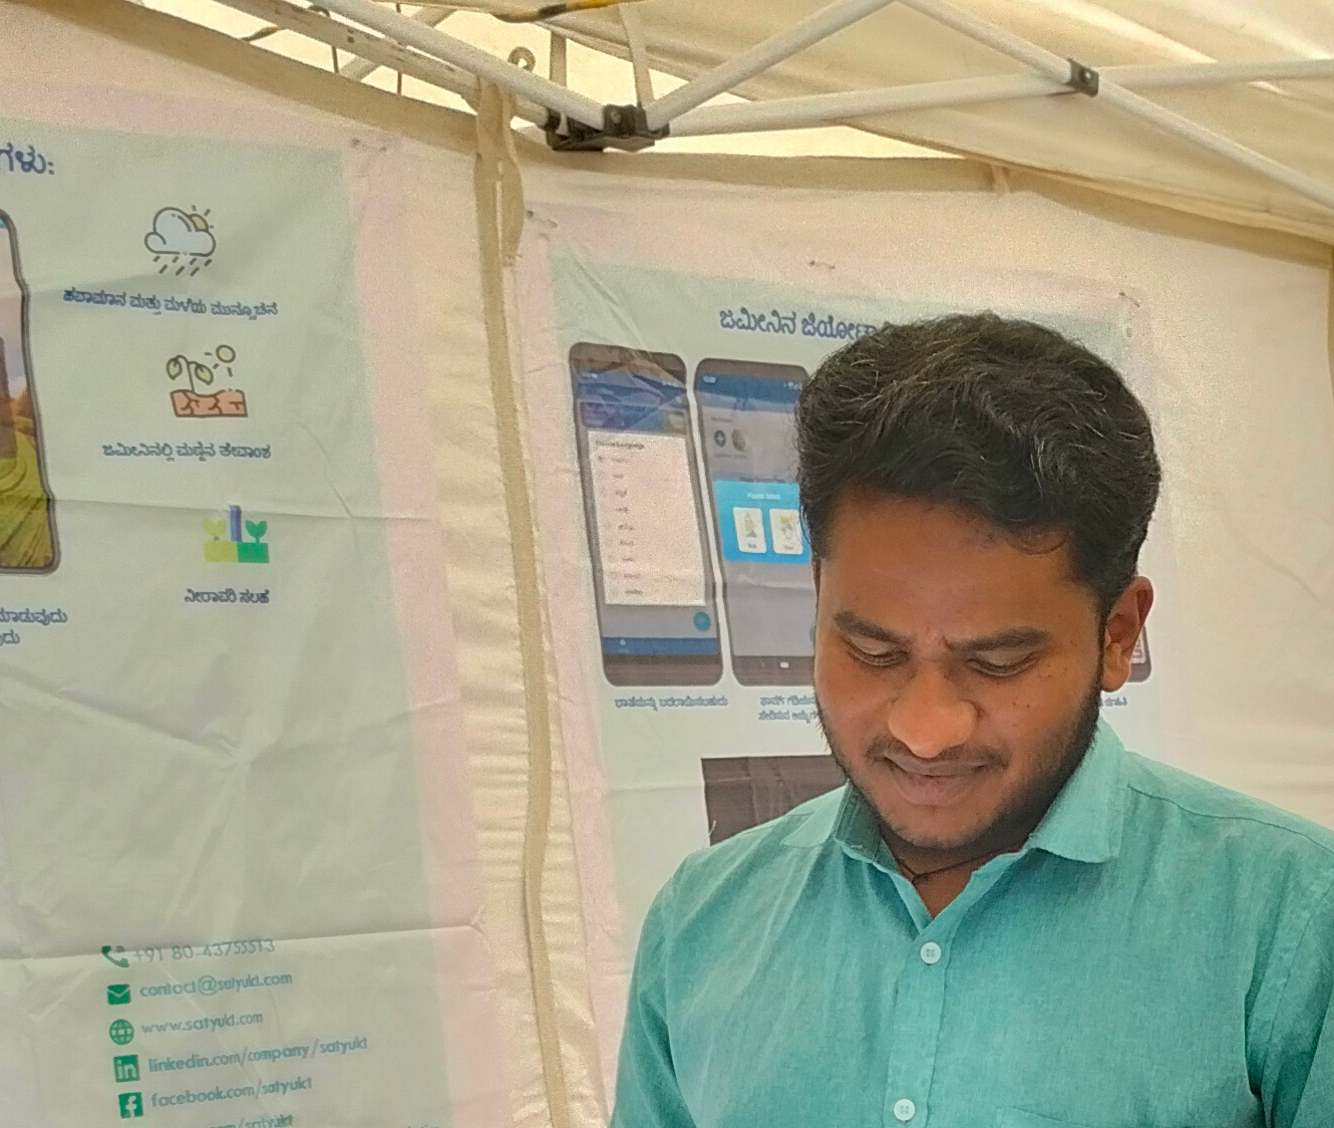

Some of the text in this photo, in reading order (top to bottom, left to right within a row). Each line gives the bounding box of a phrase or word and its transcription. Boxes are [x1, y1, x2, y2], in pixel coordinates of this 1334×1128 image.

[140, 972, 293, 998] contact@satyukt.com
[140, 1011, 264, 1034] www.satyukt.com
[151, 1076, 313, 1108] facebook.com/satyukt
